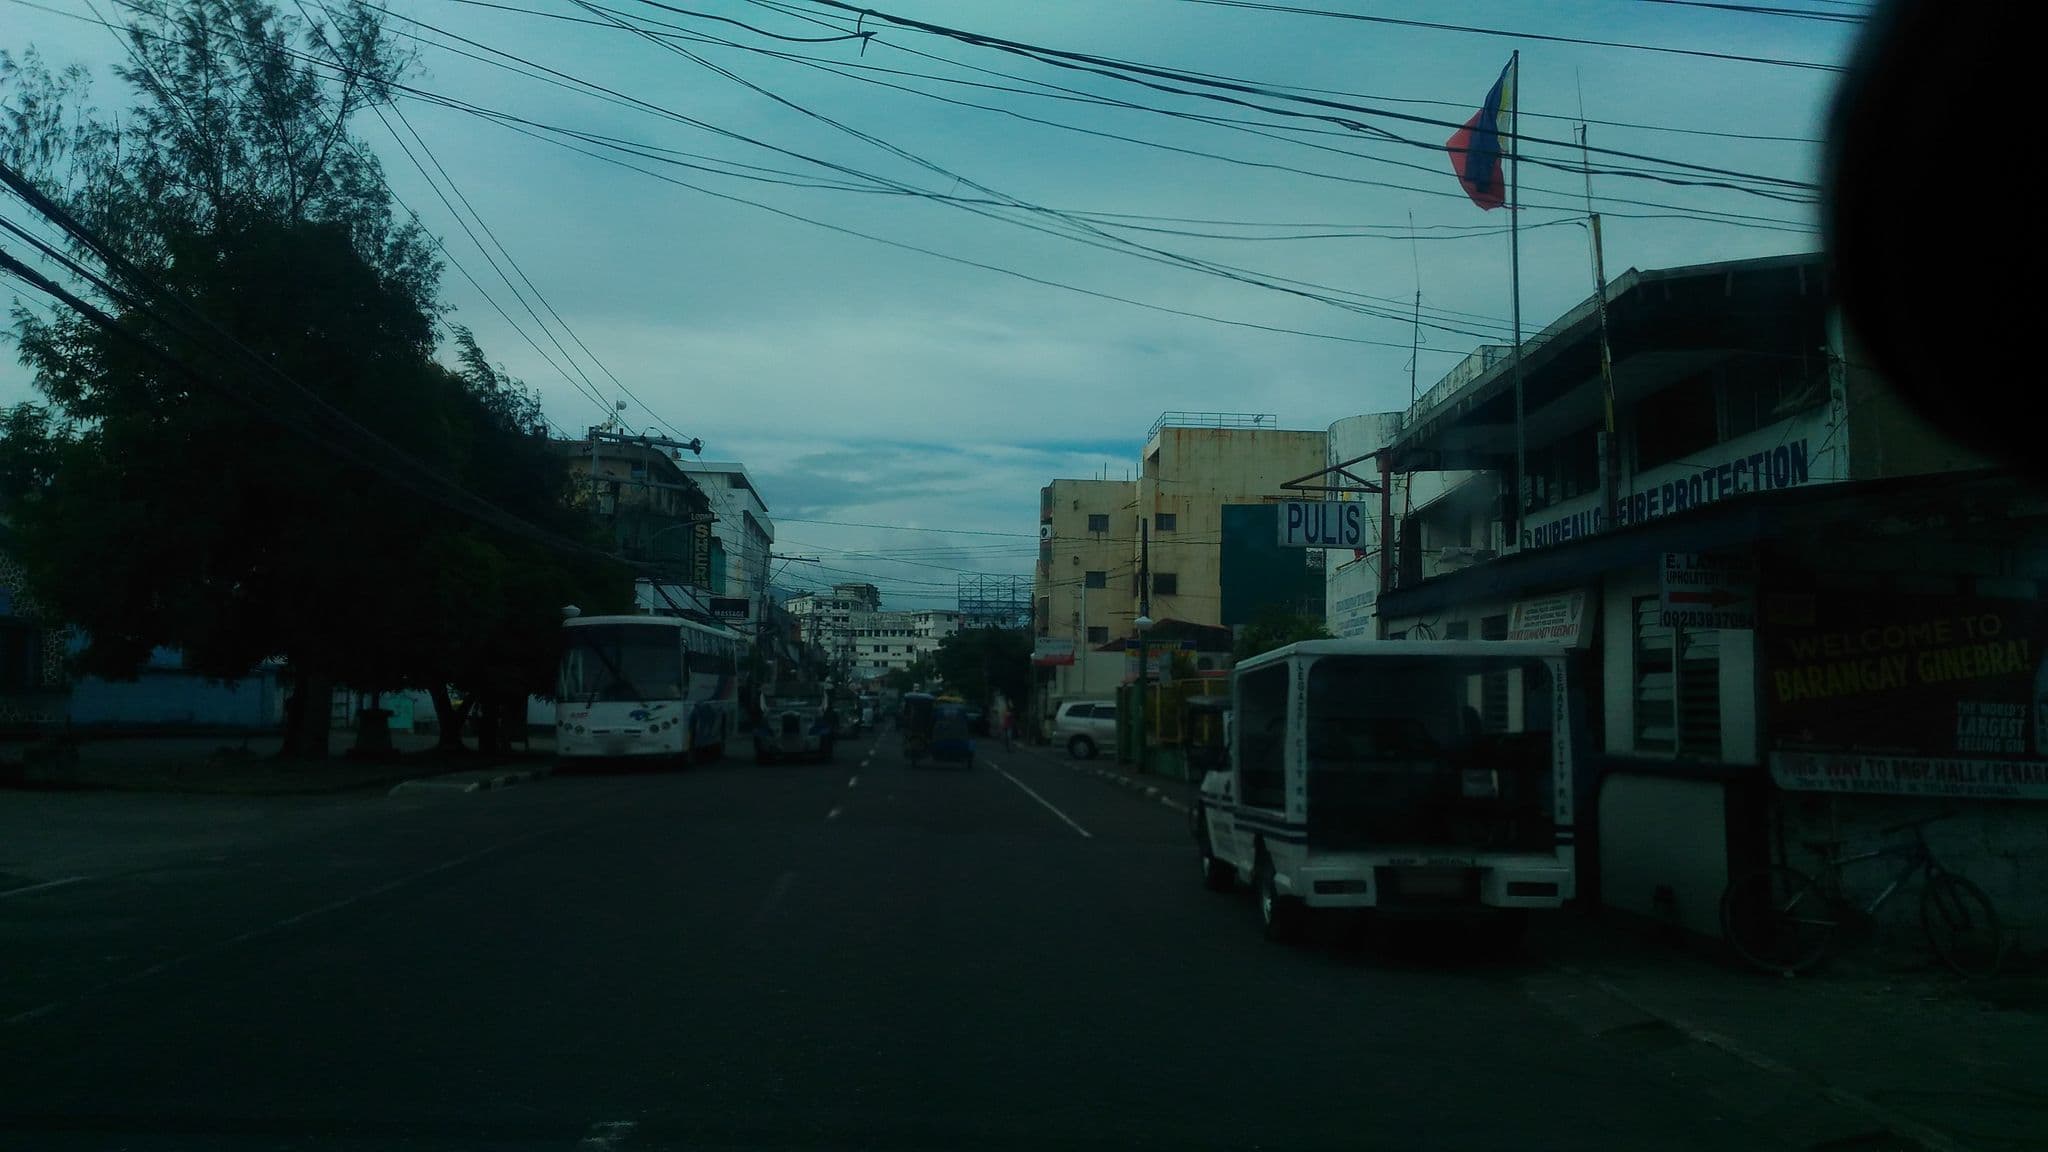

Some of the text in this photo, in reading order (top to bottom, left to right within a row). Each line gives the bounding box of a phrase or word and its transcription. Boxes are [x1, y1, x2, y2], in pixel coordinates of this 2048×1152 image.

[1534, 510, 1591, 549] BUREAU
[1616, 487, 1659, 528] FIRE
[1661, 438, 1809, 509] PROTECTION
[1287, 502, 1361, 545] PULIS
[1790, 613, 2002, 658] WELCOME TO
[1774, 638, 2033, 703] BARANGAY GINEBRA!
[1956, 716, 2025, 737] LARGEST
[1866, 758, 1887, 778] TO
[1935, 761, 1975, 783] HALL
